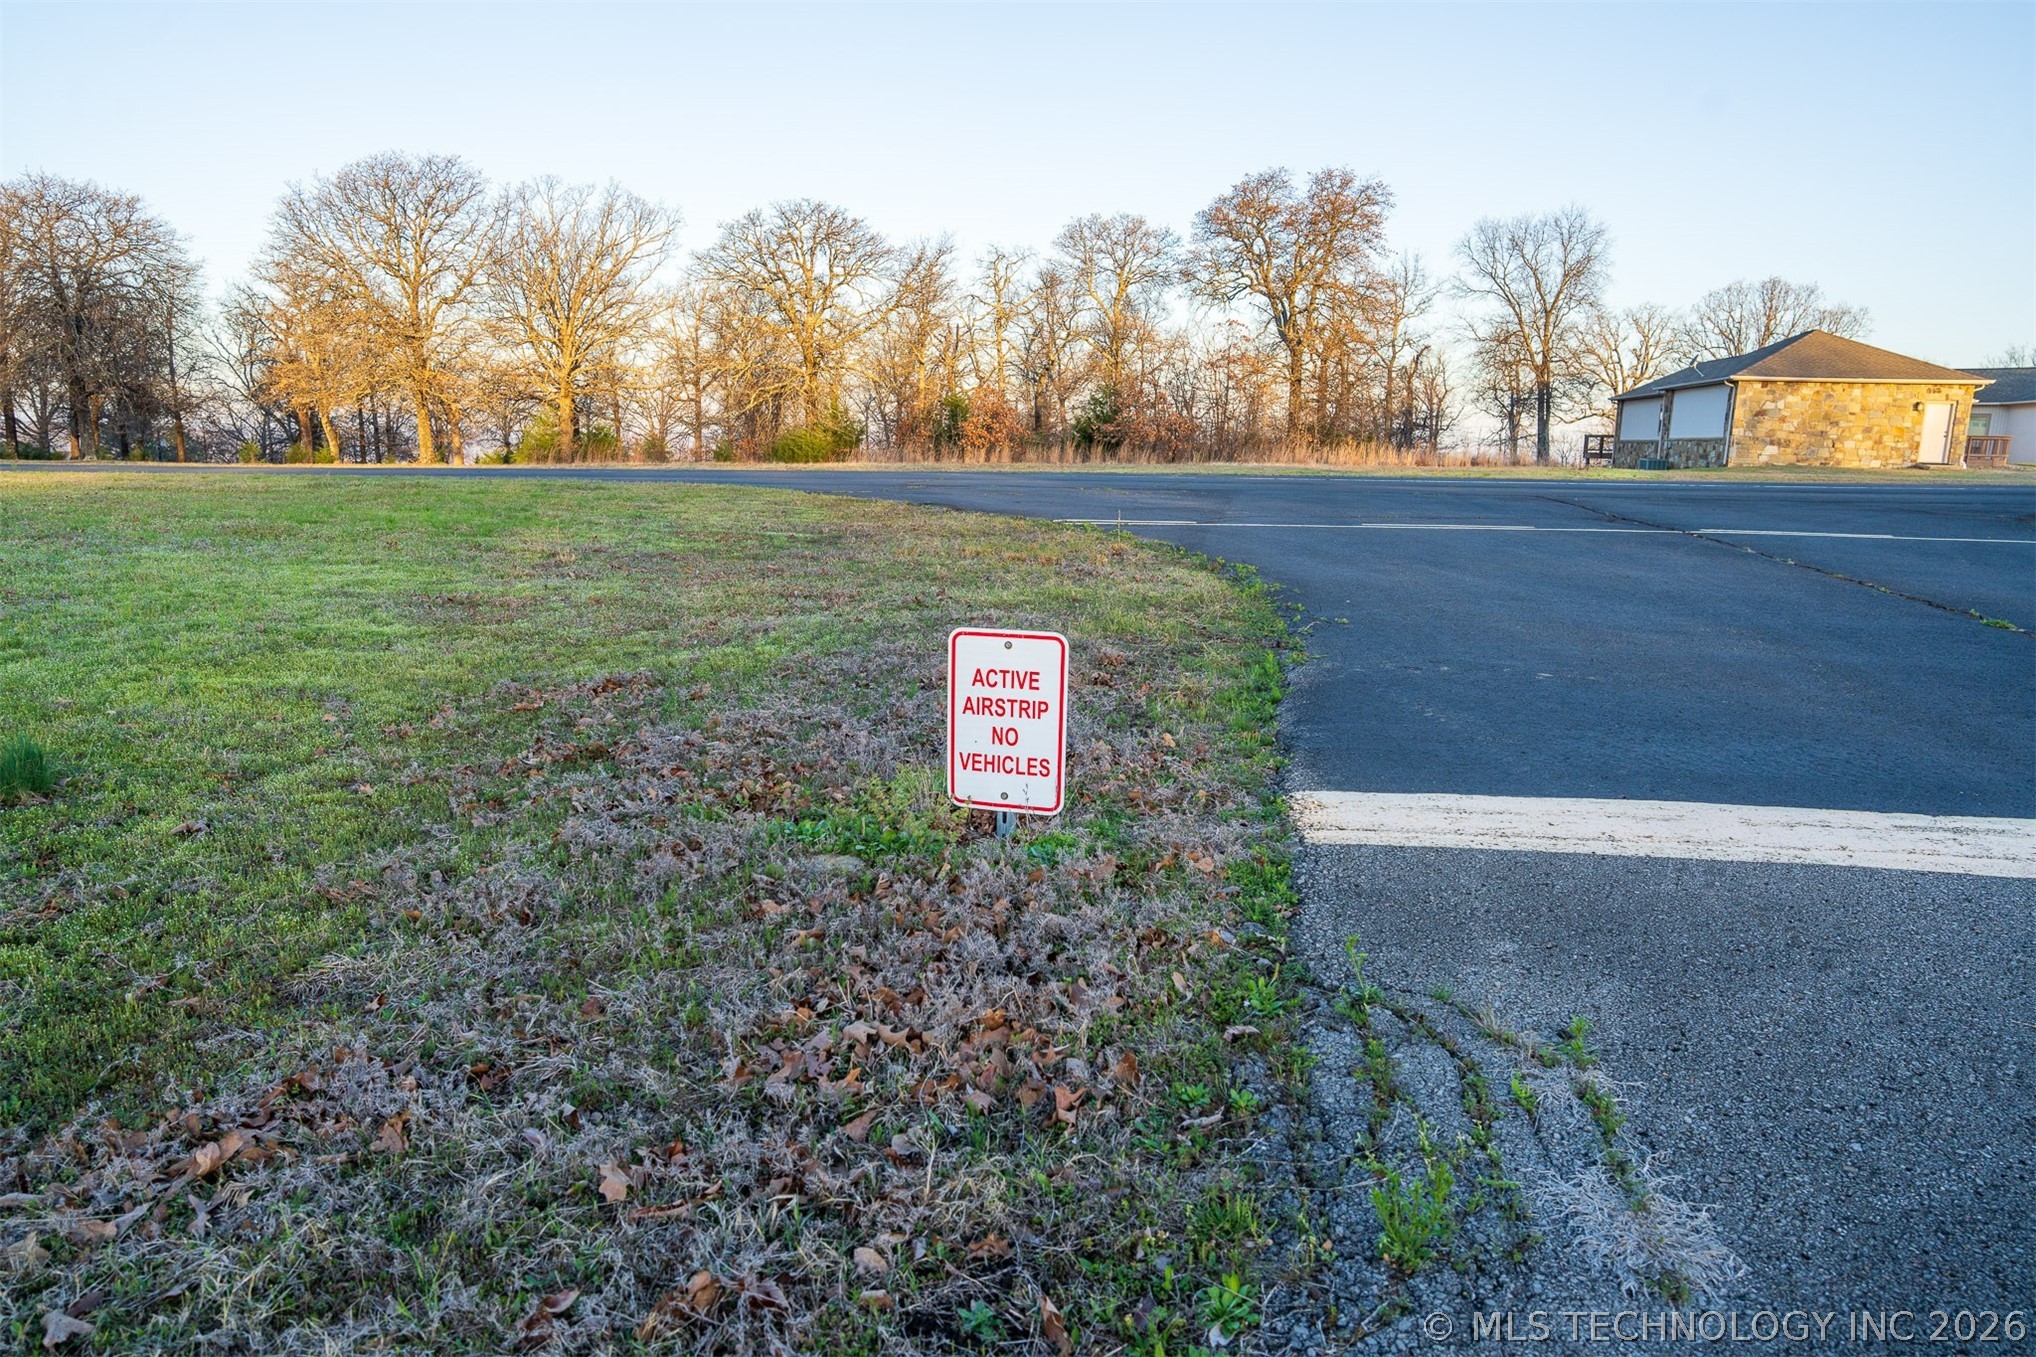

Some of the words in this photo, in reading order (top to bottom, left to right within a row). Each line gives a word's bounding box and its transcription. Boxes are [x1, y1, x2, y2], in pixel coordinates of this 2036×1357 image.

[972, 668, 1040, 690] ACTIVE
[963, 696, 1049, 719] AIRSTRIP
[991, 726, 1019, 746] NO
[959, 752, 1050, 777] VEHICLES
